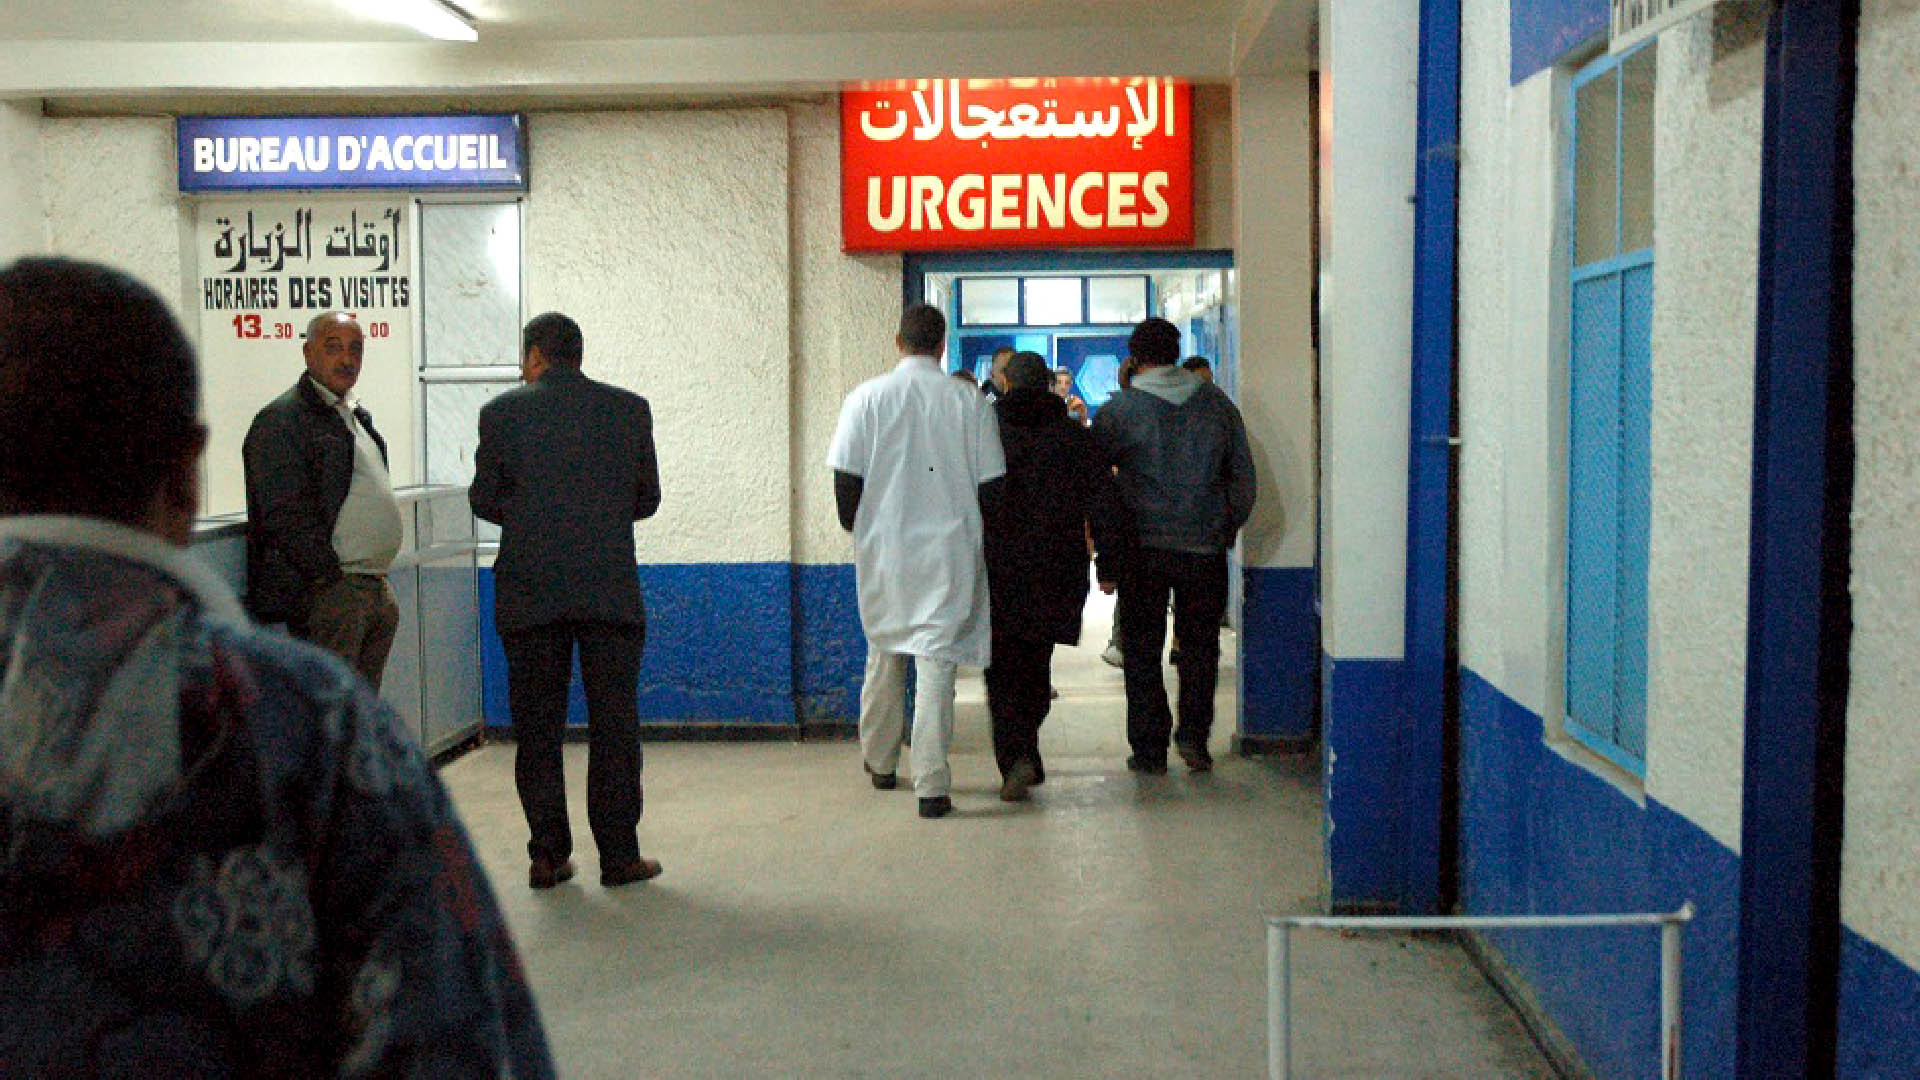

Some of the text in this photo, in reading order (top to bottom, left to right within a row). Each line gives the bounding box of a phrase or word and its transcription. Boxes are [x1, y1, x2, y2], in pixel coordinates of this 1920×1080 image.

[861, 78, 1175, 149] الإستعجالات
[193, 134, 507, 173] BUREAU D'ACCUEIL
[867, 171, 1170, 232] URGENCES
[214, 207, 401, 272] أوقات الزيارة
[203, 276, 410, 310] HORAIRES DES VISITES
